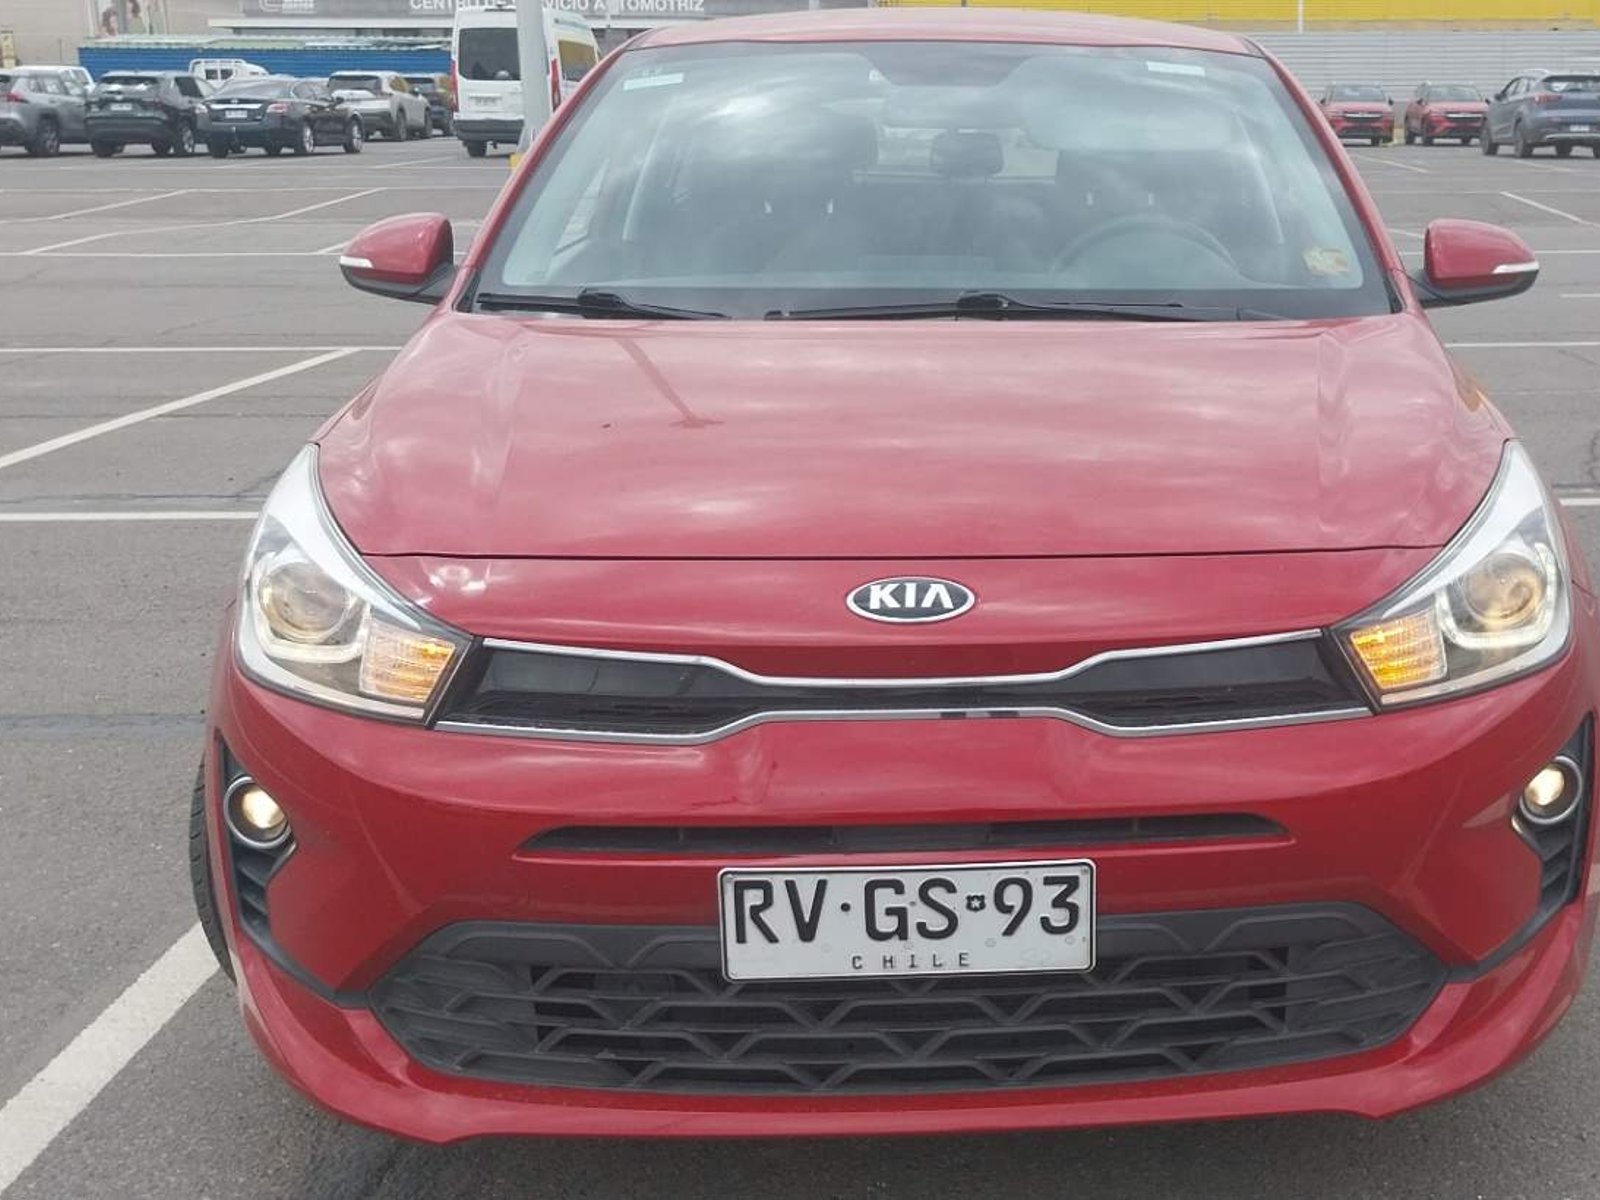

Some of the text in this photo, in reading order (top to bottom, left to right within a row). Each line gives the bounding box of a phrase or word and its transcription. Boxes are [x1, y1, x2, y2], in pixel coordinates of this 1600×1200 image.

[593, 0, 706, 12] ATOMOTRIZ
[869, 582, 955, 609] KIA
[851, 952, 970, 970] CHILE
